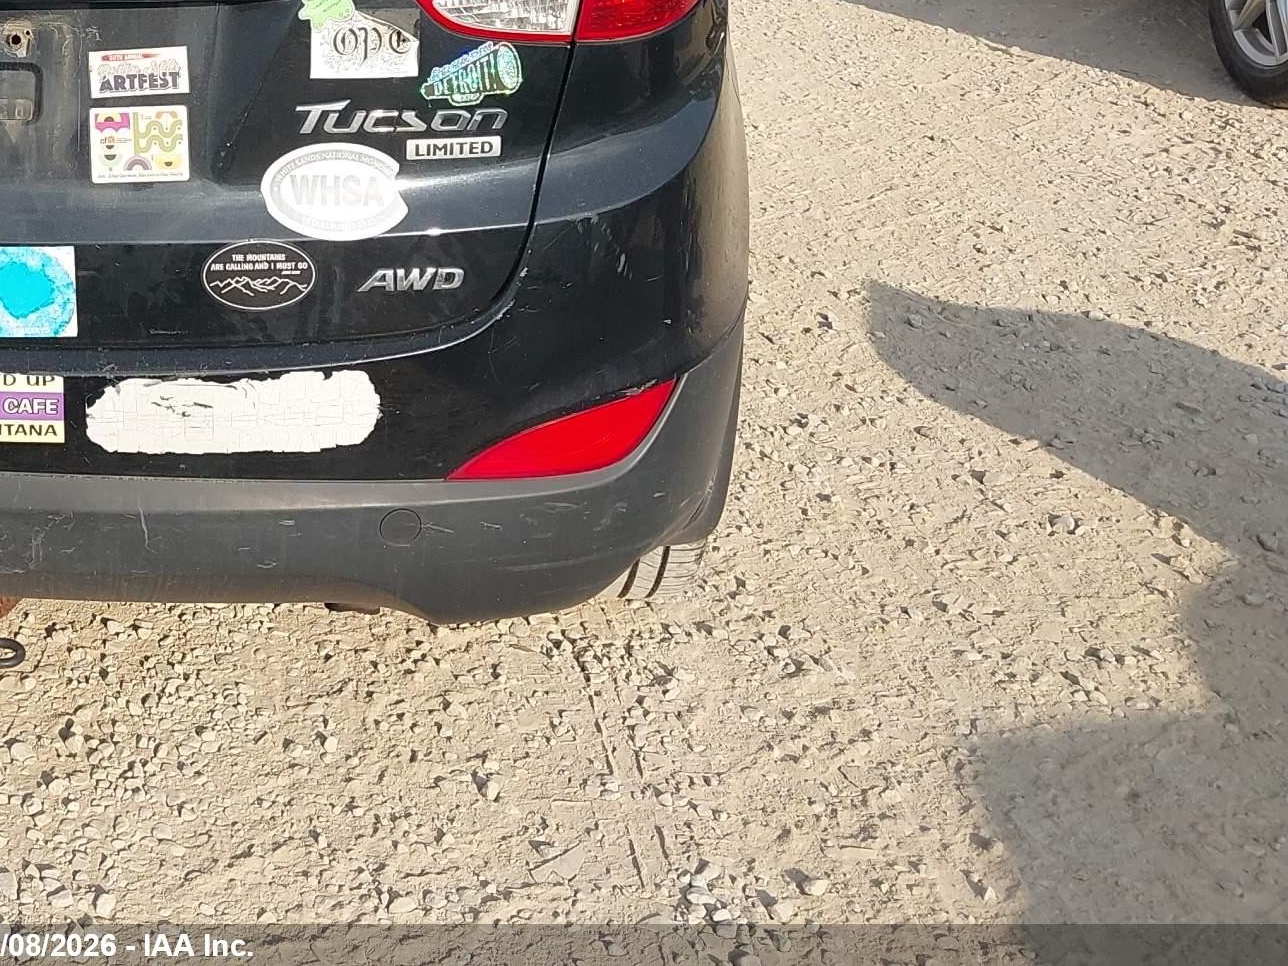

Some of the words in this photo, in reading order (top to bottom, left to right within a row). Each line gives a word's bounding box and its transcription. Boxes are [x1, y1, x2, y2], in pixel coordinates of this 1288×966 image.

[99, 72, 180, 93] ARTFEST
[415, 141, 493, 156] LIMITED
[290, 174, 385, 206] WHSA
[232, 254, 245, 262] THE
[246, 253, 286, 262] MOUNTAINS
[211, 263, 224, 271] ARE
[225, 262, 253, 271] CALLING
[254, 261, 269, 270] AND
[276, 262, 296, 270] MUST
[297, 262, 308, 270] GO
[357, 267, 465, 292] AWD
[26, 375, 56, 387] UP
[2, 398, 59, 416] CAFE
